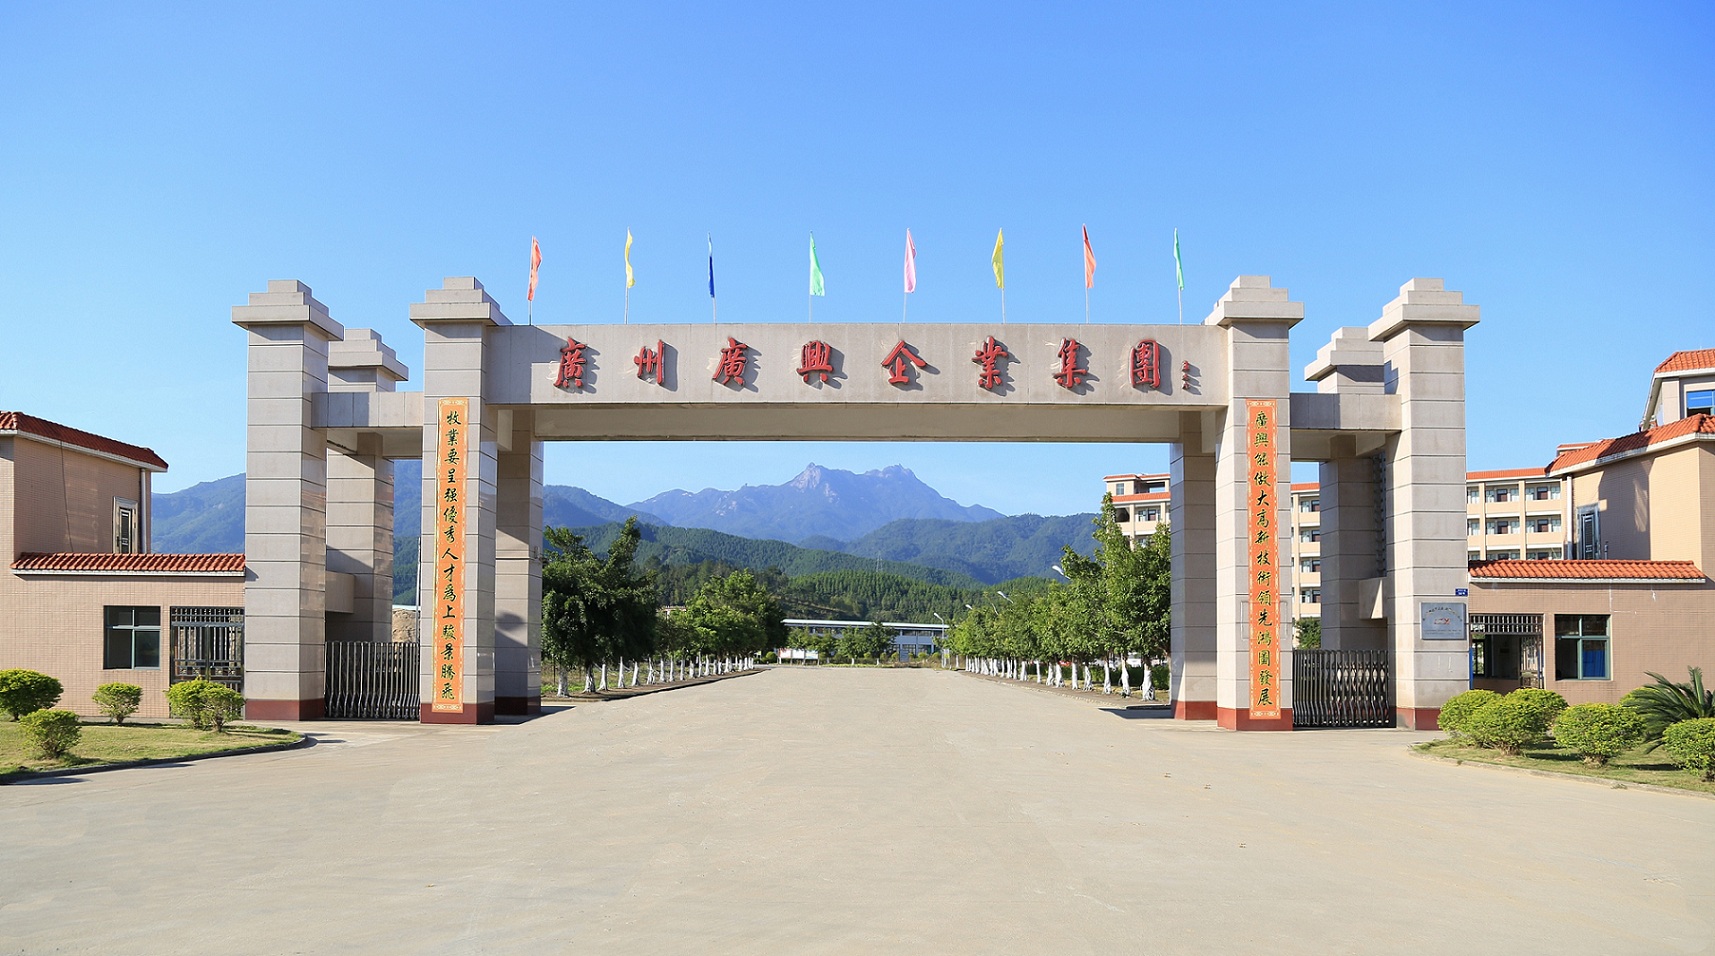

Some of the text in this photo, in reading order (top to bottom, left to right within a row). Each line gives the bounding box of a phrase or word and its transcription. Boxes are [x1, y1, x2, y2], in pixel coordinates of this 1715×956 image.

[553, 336, 1160, 389] 廣州廣興企業集團
